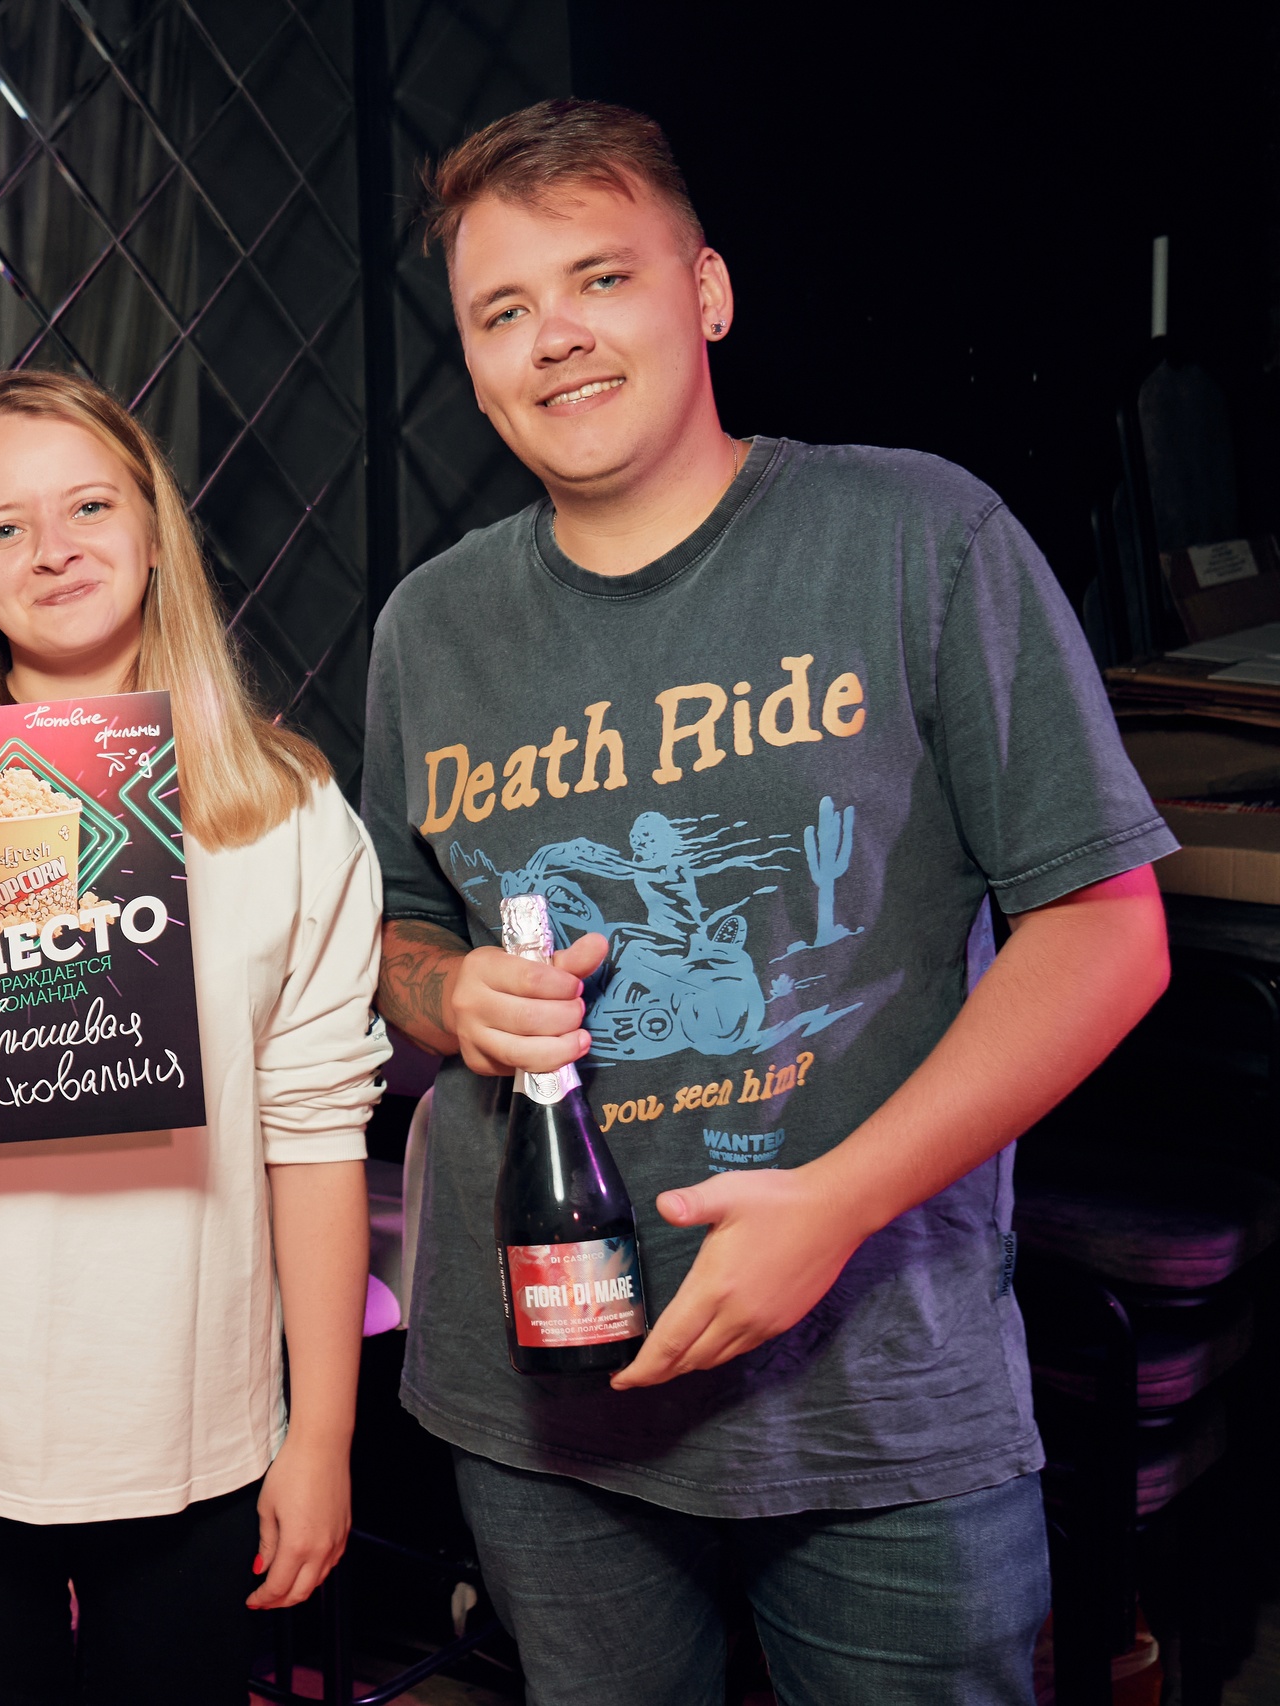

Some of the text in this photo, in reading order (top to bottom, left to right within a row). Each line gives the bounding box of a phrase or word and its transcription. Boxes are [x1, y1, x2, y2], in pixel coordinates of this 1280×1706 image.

[94, 724, 160, 749] фильмы
[420, 653, 867, 836] Death Ride
[4, 841, 51, 865] Fresh
[599, 1051, 815, 1133] you seen him?
[703, 1128, 785, 1152] WANTED
[550, 1256, 561, 1264] DI
[524, 1275, 635, 1308] FIORI DI MARE
[530, 1319, 568, 1327] ИГРИСТОЕ
[570, 1313, 618, 1325] ЖЕМЧУЖНОЕ
[577, 1319, 629, 1333] ПОЛУСЛАДКОЕ
